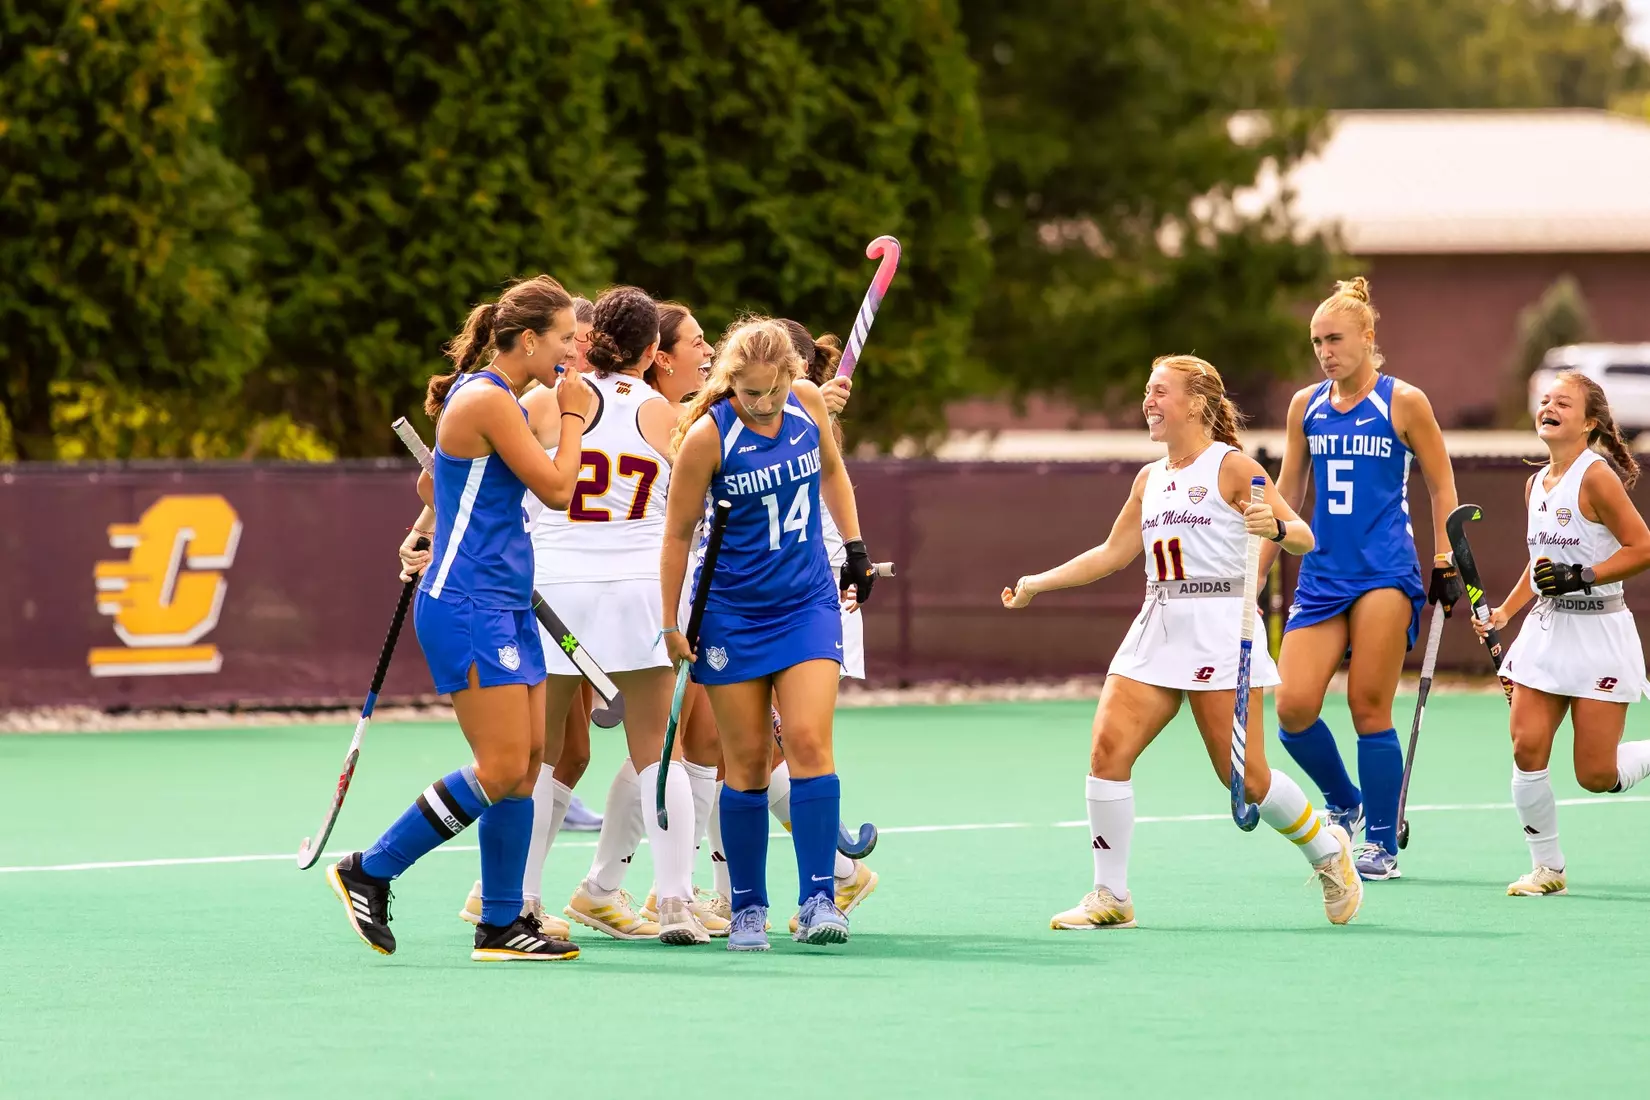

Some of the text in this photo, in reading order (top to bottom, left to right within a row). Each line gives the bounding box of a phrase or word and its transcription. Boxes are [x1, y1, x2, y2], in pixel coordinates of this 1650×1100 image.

[1307, 434, 1393, 458] AINT LOUIS
[567, 448, 660, 523] 27
[724, 463, 782, 495] SAINT
[1327, 459, 1354, 515] 5
[761, 482, 811, 551] 14
[1162, 510, 1212, 528] Michigan
[1538, 531, 1580, 549] Michigan
[1152, 537, 1186, 581] 11
[1179, 581, 1231, 594] ADIDAS
[1556, 599, 1605, 611] ADIDAS
